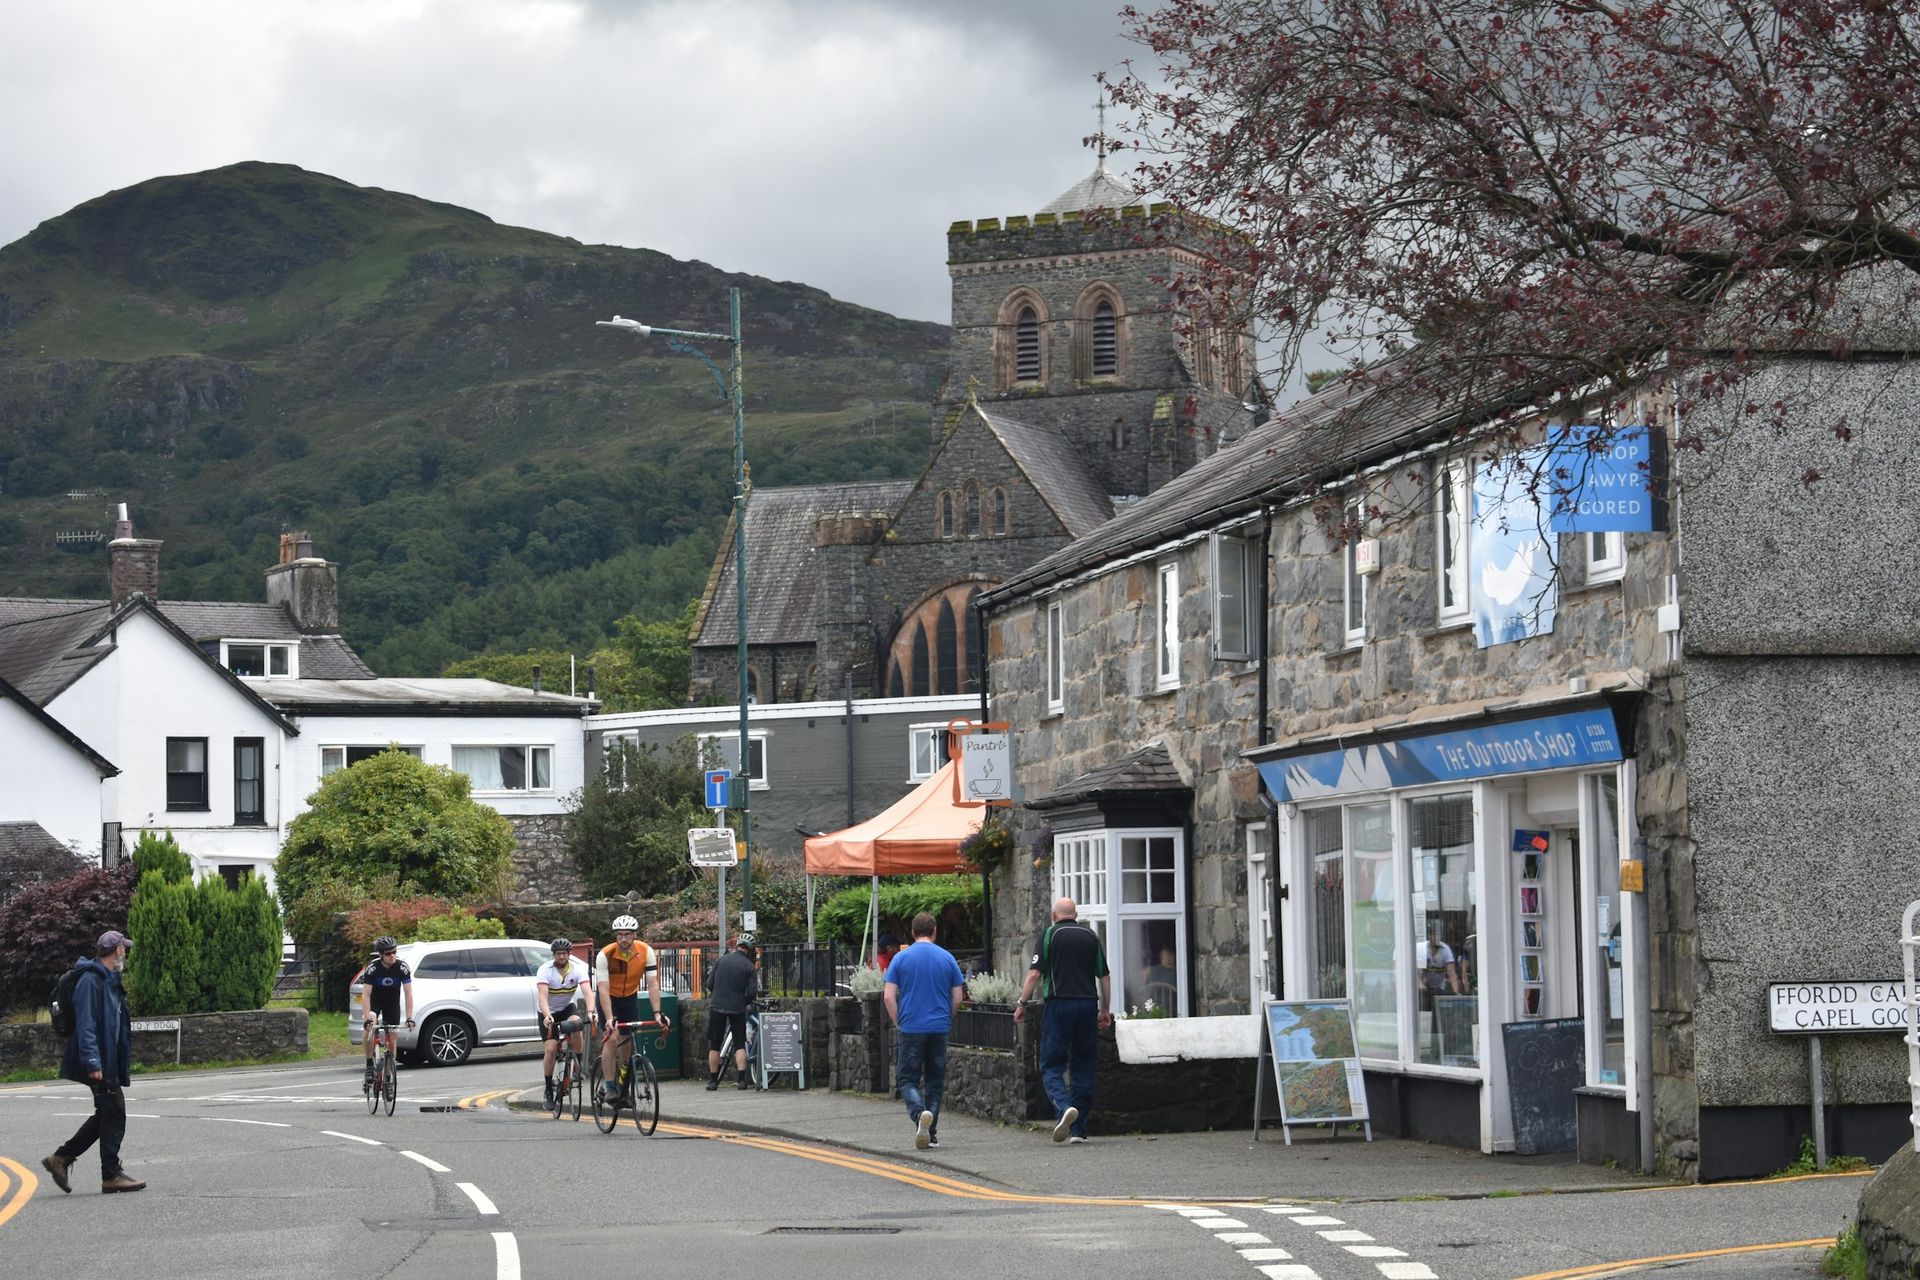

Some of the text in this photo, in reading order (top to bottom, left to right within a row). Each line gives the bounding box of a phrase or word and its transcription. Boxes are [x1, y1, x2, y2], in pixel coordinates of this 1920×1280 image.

[1587, 473, 1640, 488] AWYR
[1569, 500, 1640, 515] GORED
[967, 740, 1006, 751] Pantri
[1436, 730, 1577, 771] THE OUTDOOR SHOP
[1776, 986, 1858, 1004] FFORDD
[1794, 1008, 1861, 1027] CAPEL
